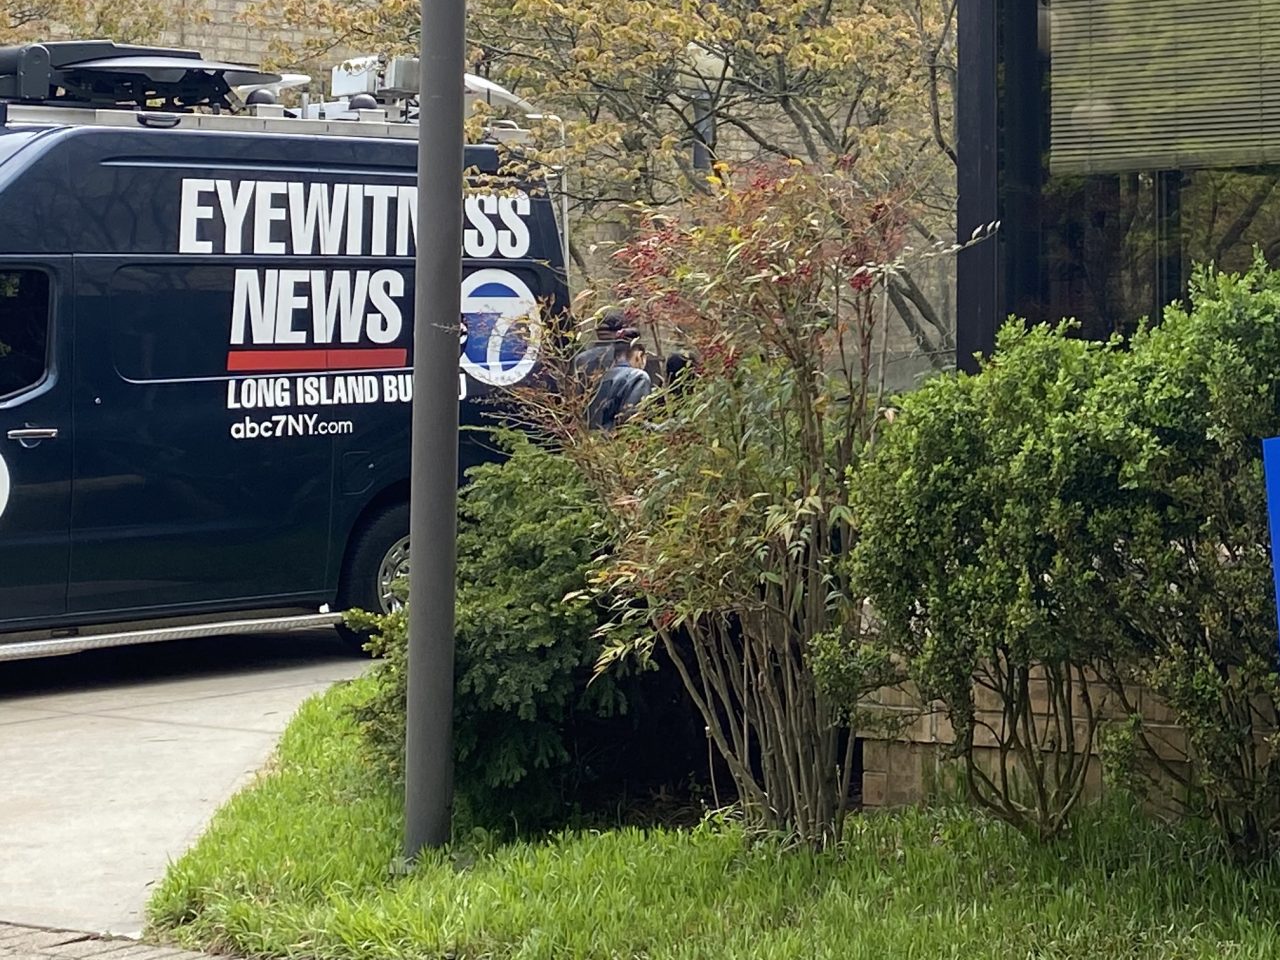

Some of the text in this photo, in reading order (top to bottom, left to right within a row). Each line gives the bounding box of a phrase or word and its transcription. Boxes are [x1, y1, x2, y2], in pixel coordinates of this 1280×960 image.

[179, 178, 531, 258] EYEWITNSS
[230, 269, 404, 346] NEWS
[227, 375, 468, 408] LONG ISLAND BUU
[230, 414, 353, 439] abc7NY.com
